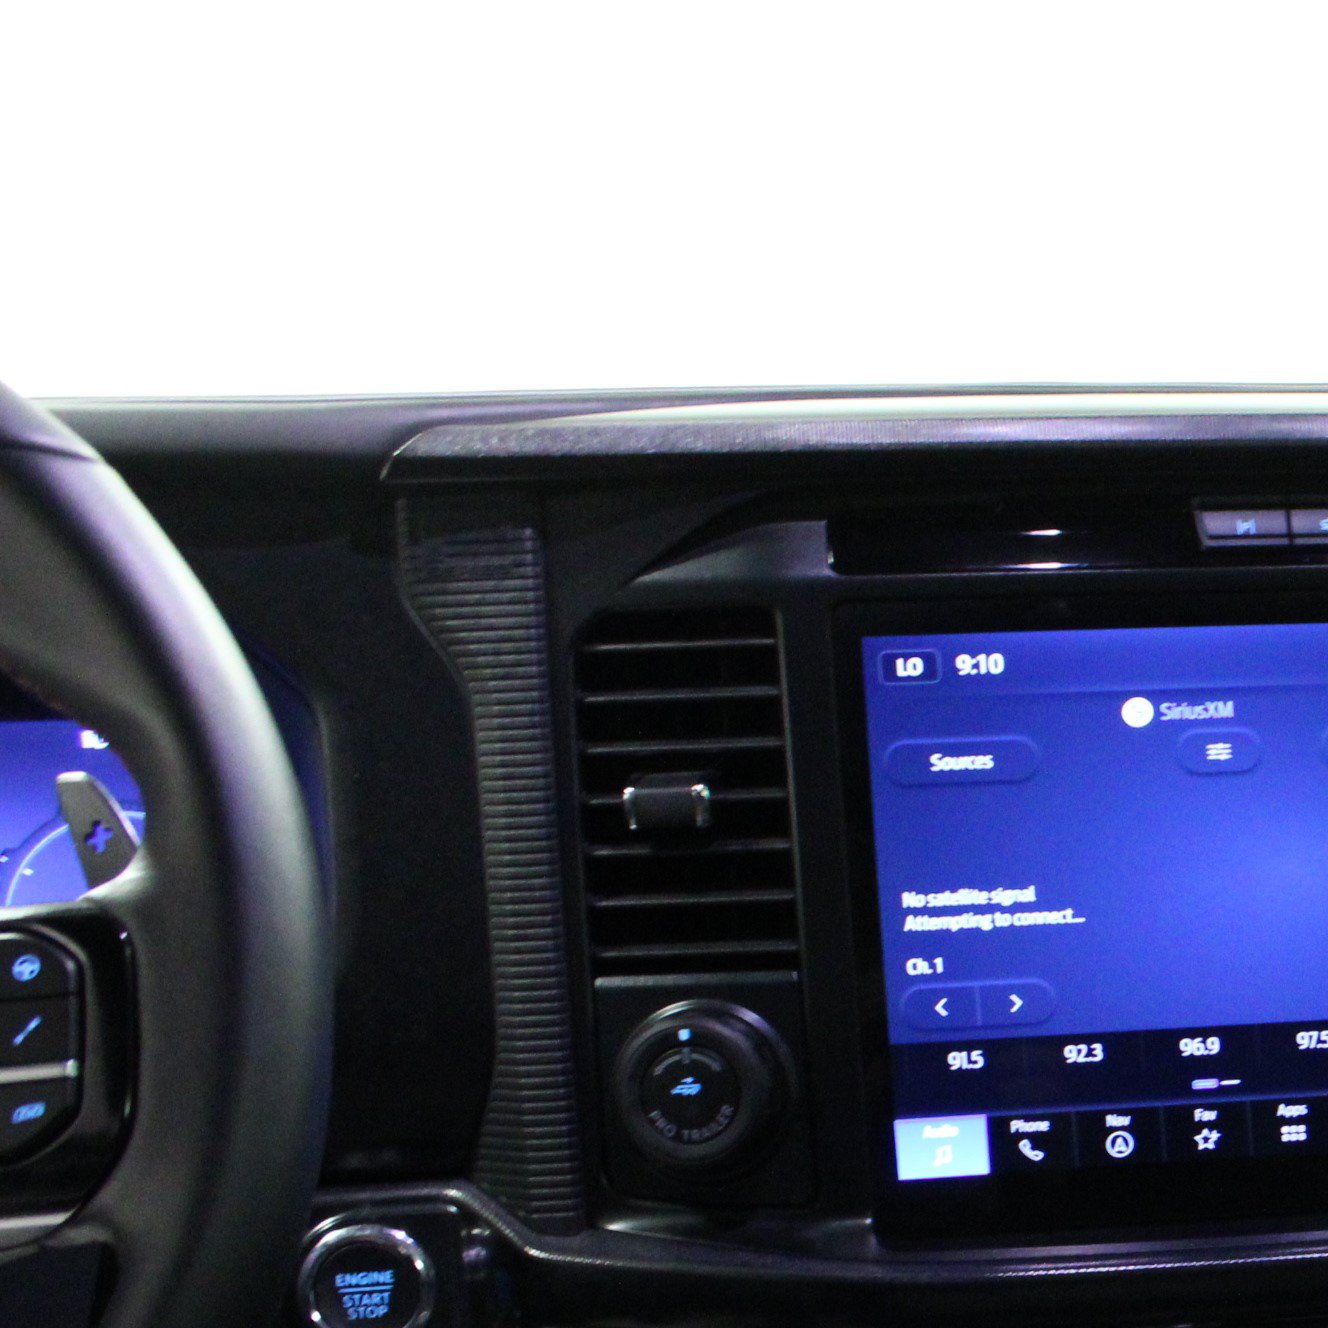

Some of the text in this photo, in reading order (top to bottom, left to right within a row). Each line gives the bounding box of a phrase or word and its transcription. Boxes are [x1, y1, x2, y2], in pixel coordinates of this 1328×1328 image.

[895, 656, 925, 678] LO
[954, 652, 1005, 676] 9:10
[1158, 700, 1236, 721] SiriusXM
[928, 752, 995, 772] Sources
[901, 885, 1036, 909] No satellite signal
[903, 913, 994, 933] Attempting
[994, 910, 1012, 927] to
[933, 956, 944, 974] 1
[1063, 1042, 1104, 1064] 92.3
[1178, 1036, 1221, 1057] 96.9
[946, 1049, 985, 1071] 91.5
[1105, 1113, 1132, 1128] Nav
[1193, 1107, 1218, 1122] Fav
[1276, 1103, 1309, 1119] Apps
[1009, 1118, 1051, 1134] Phone
[335, 1270, 395, 1287] ENGINE
[343, 1292, 390, 1308] START
[347, 1305, 388, 1320] STOP
